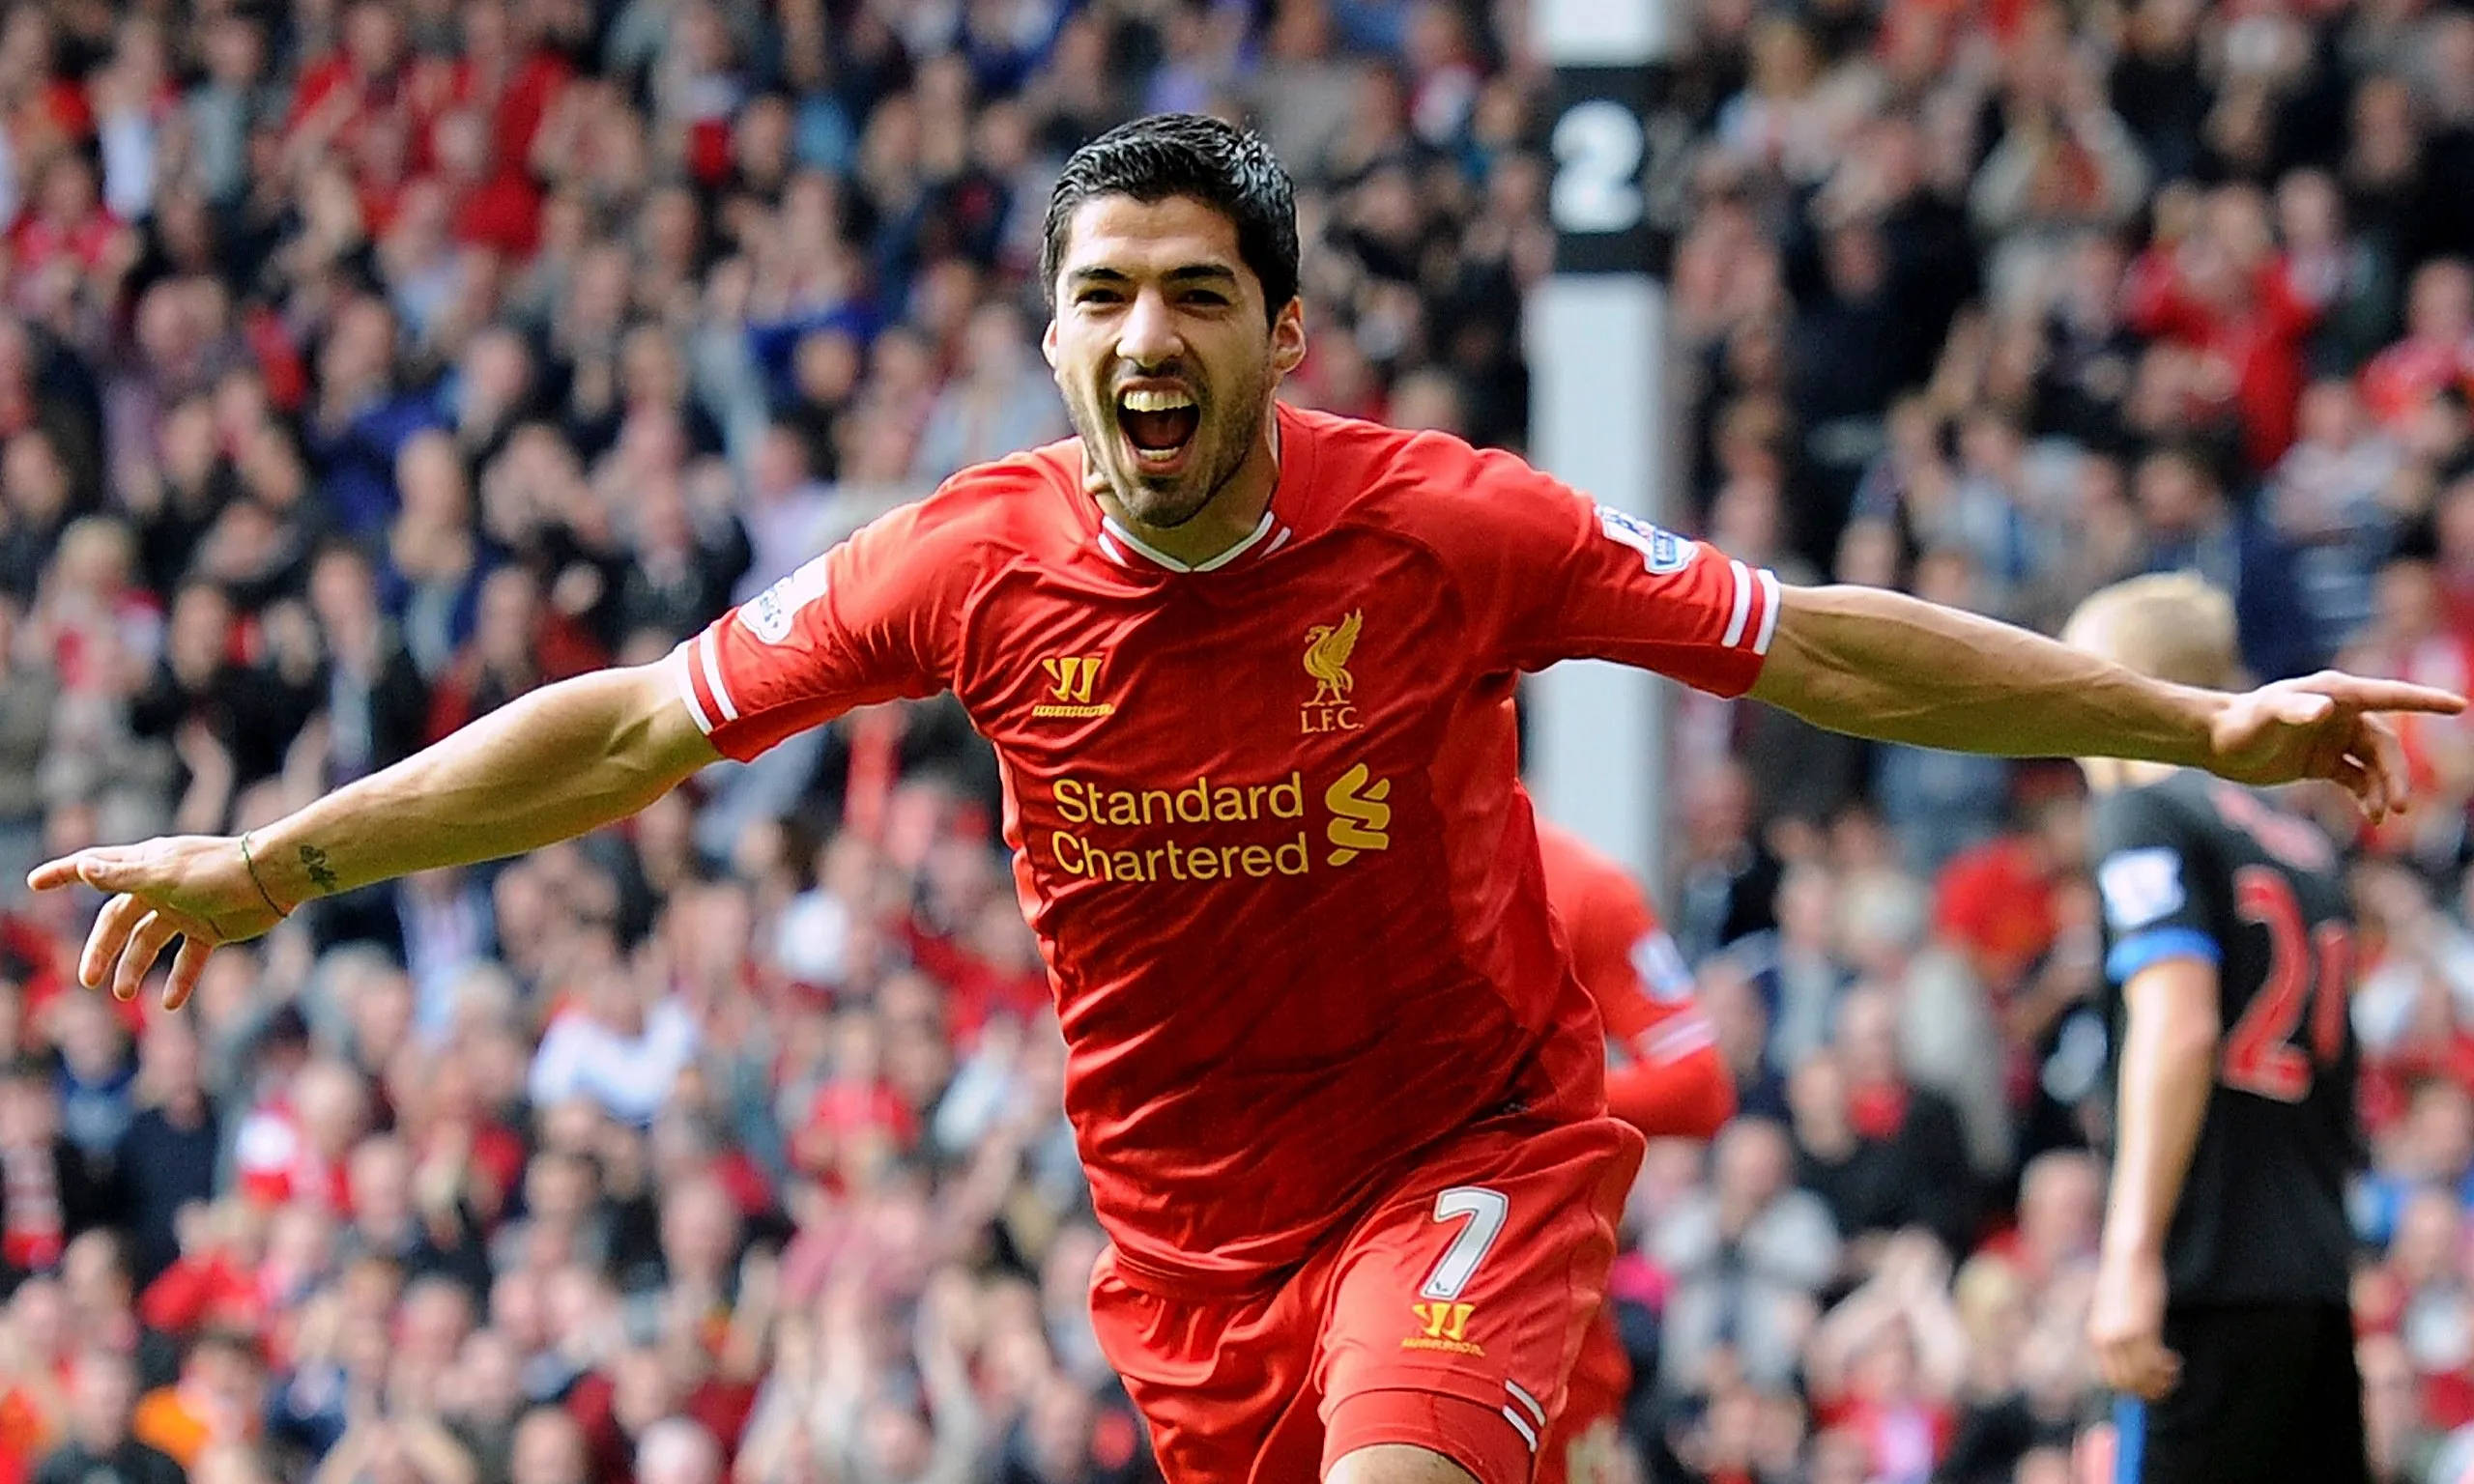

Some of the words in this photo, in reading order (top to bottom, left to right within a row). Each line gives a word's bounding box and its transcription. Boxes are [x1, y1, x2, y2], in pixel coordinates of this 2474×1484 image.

[1550, 98, 1644, 233] 2
[1300, 706, 1364, 734] L.F.C.
[1051, 772, 1305, 825] Standard
[1051, 831, 1309, 882] Chartered
[2224, 864, 2352, 1104] 21
[1420, 1185, 1510, 1301] 7
